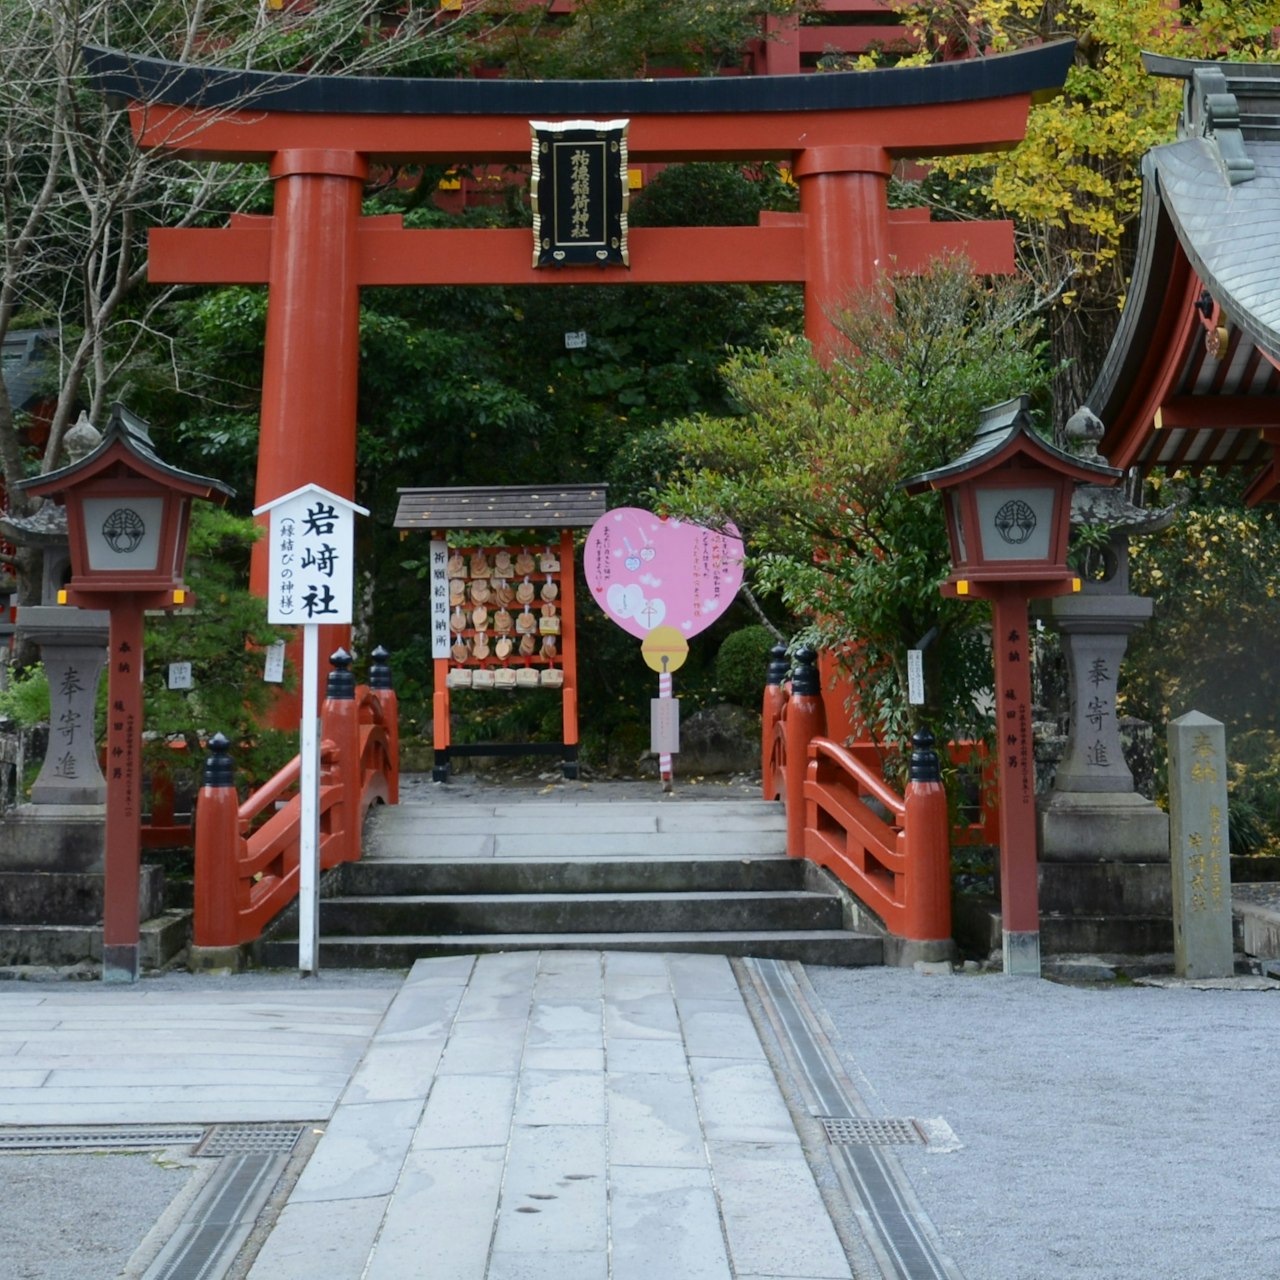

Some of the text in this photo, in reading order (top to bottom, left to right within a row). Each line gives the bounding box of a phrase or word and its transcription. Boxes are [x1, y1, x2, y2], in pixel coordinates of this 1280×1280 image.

[434, 551, 447, 647] 祈願絵馬納所
[55, 667, 85, 780] 奉寄進
[1085, 658, 1112, 768] 奉寄進
[1191, 732, 1218, 785] 奉納
